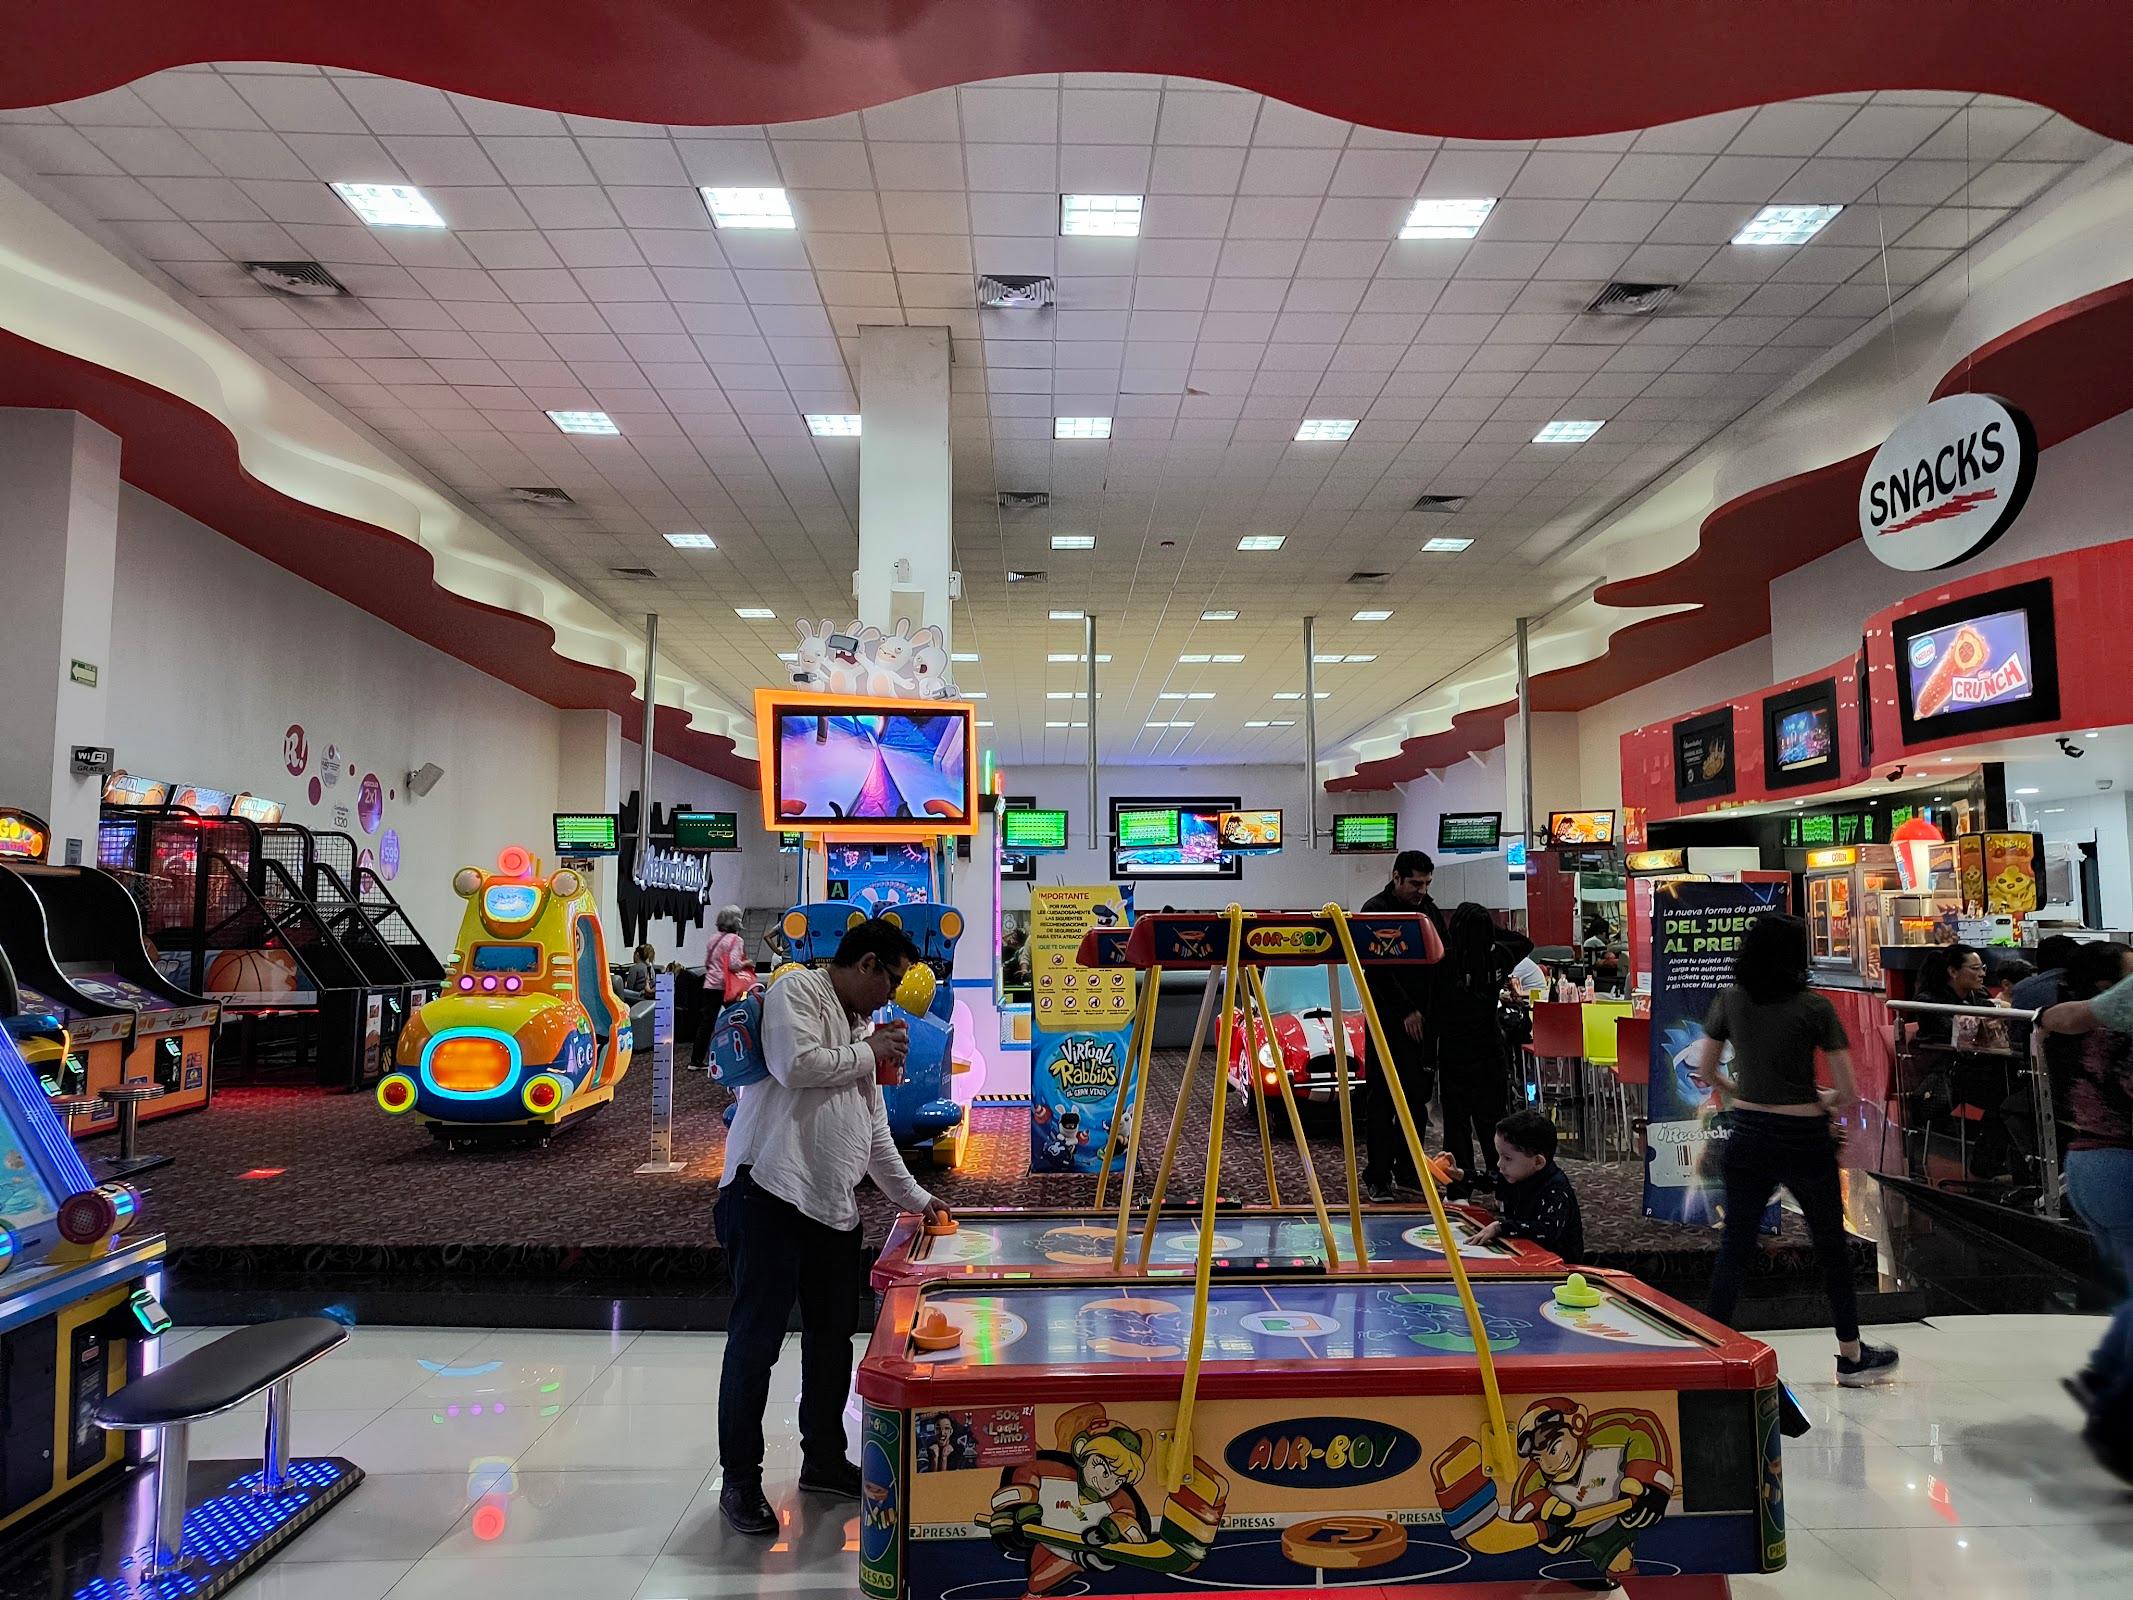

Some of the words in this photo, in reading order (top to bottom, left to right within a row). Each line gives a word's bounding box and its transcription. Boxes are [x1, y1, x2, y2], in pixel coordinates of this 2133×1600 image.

[1870, 421, 2005, 527] SNACKS
[1954, 659, 2023, 699] CRUNCH
[77, 765, 105, 773] GRATIS
[1039, 892, 1089, 900] IMPORTANTE
[1663, 909, 1674, 917] La
[1675, 907, 1702, 916] nueva
[1704, 906, 1732, 915] forma
[1734, 905, 1747, 913] de
[1748, 904, 1776, 915] ganar
[1665, 919, 1702, 935] DEL
[1706, 916, 1759, 933] JUEG
[1250, 931, 1328, 947] AIR-BOY
[1663, 937, 1688, 954] AL
[1698, 957, 1722, 965] tarjeta
[1667, 974, 1677, 982] los
[1701, 974, 1715, 982] que
[1701, 981, 1717, 989] filas
[1717, 981, 1734, 989] para
[991, 1410, 1020, 1421] -50%
[1248, 1435, 1397, 1470] AIR-BOY
[1232, 1517, 1276, 1528] PRESAS
[1399, 1512, 1442, 1523] PRESAS
[922, 1527, 967, 1538] PRESAS
